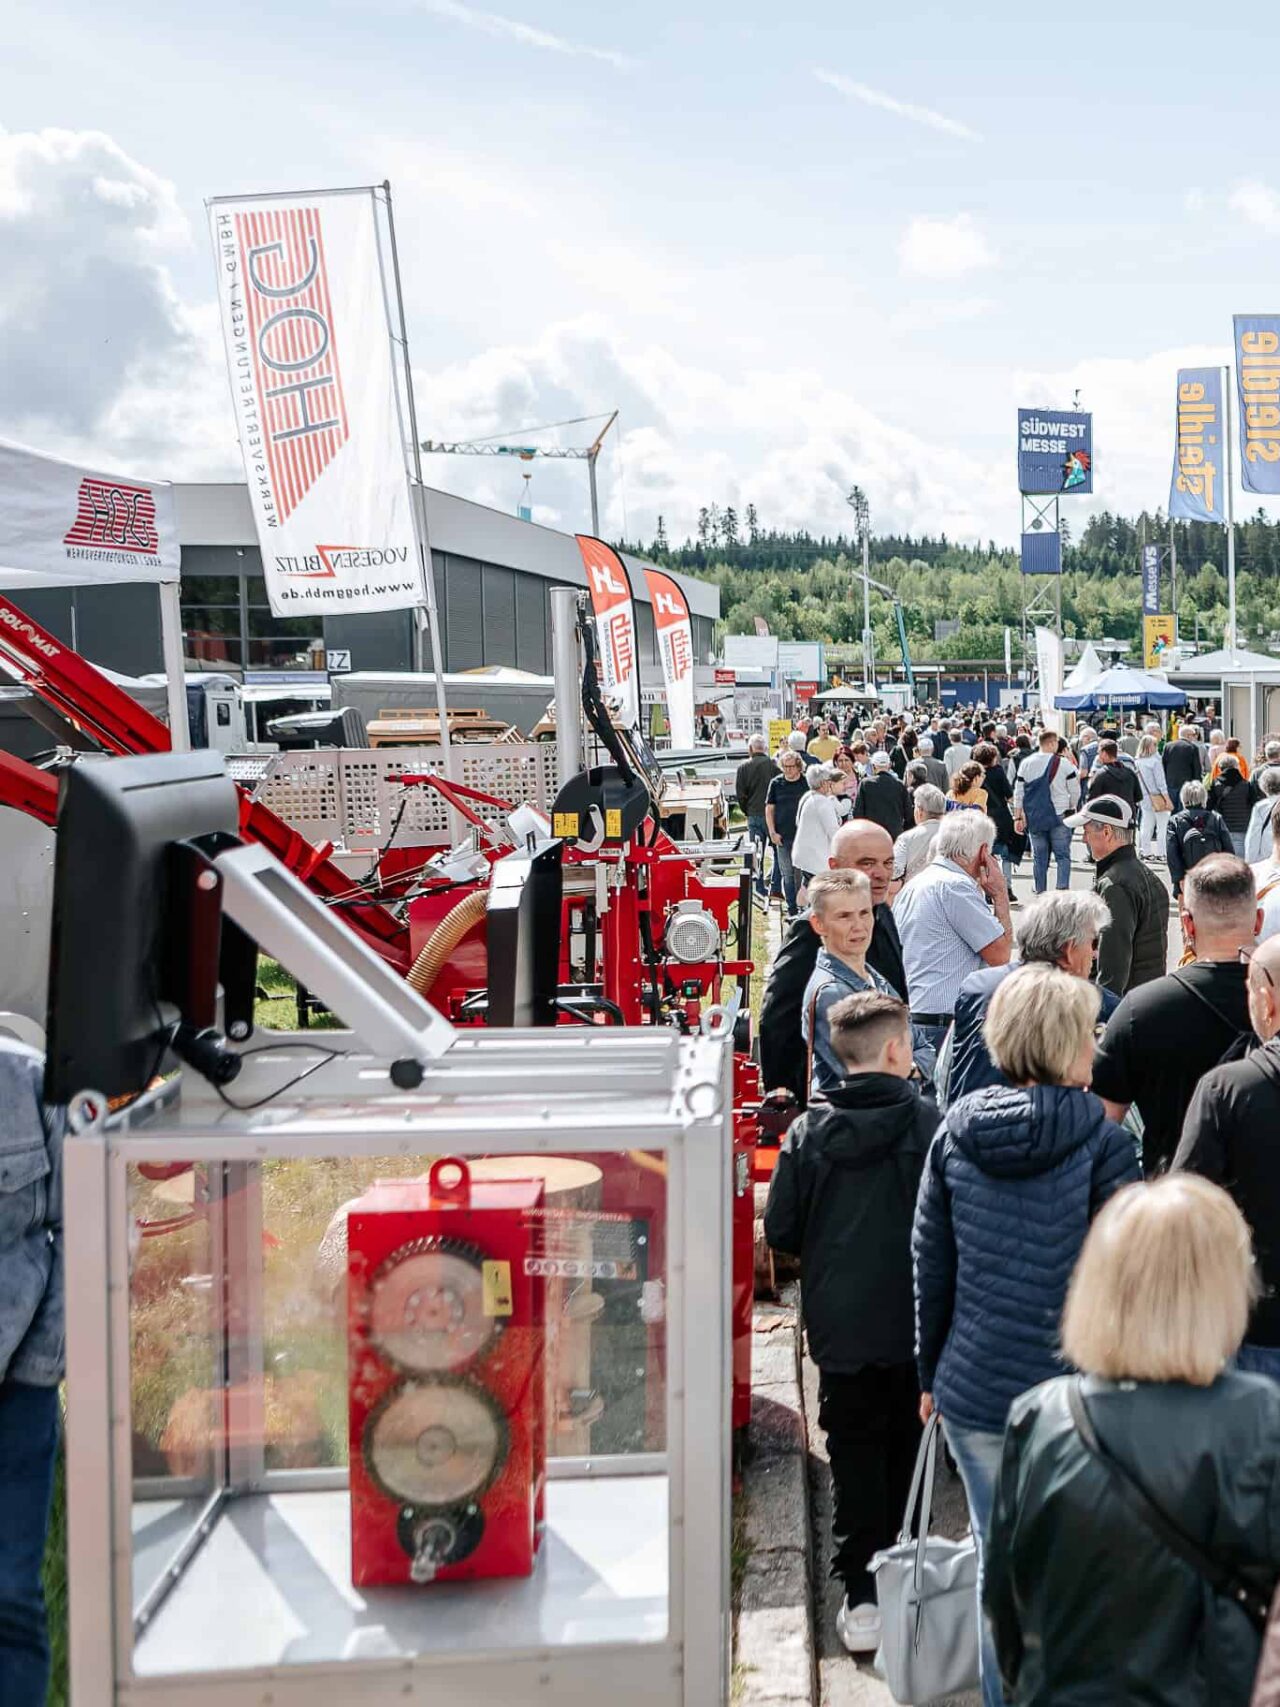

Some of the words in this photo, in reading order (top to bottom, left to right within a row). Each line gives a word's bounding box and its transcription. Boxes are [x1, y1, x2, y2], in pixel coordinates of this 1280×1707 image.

[1021, 417, 1086, 437] SÜDWEST
[1021, 438, 1066, 453] MESSE
[87, 485, 149, 547] HOG
